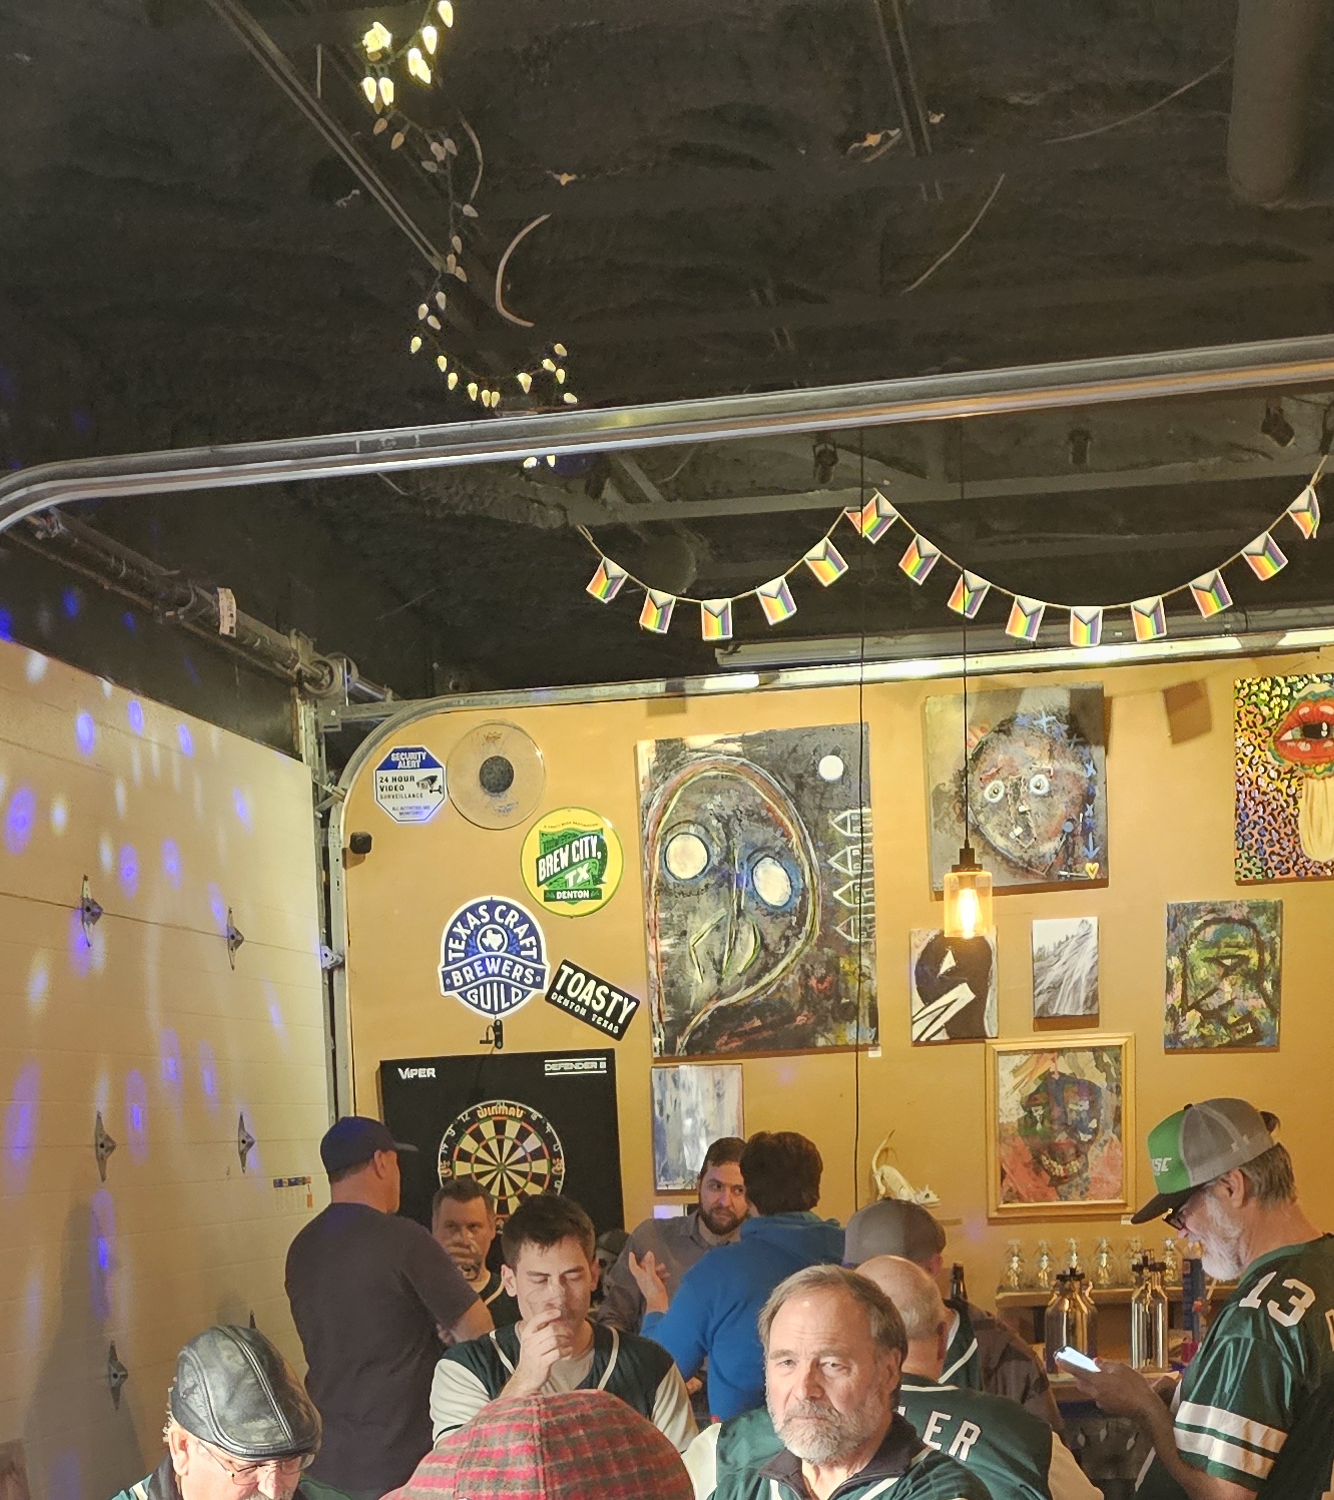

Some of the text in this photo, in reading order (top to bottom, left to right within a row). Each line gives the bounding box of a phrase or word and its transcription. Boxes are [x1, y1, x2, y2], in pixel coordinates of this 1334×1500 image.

[391, 752, 426, 761] SECURITY
[397, 760, 421, 769] ALERT
[538, 835, 602, 882] BREW CITY,
[565, 862, 590, 888] TX
[556, 890, 590, 900] DENTON
[449, 904, 538, 962] TEXAS CRAFT
[452, 957, 535, 987] BREWERS
[467, 982, 523, 1012] GUILD
[560, 964, 638, 1025] TOASTY
[550, 991, 620, 1035] DENTON TEXAS
[545, 1061, 598, 1071] DEFENDER
[1239, 1271, 1316, 1327] 13
